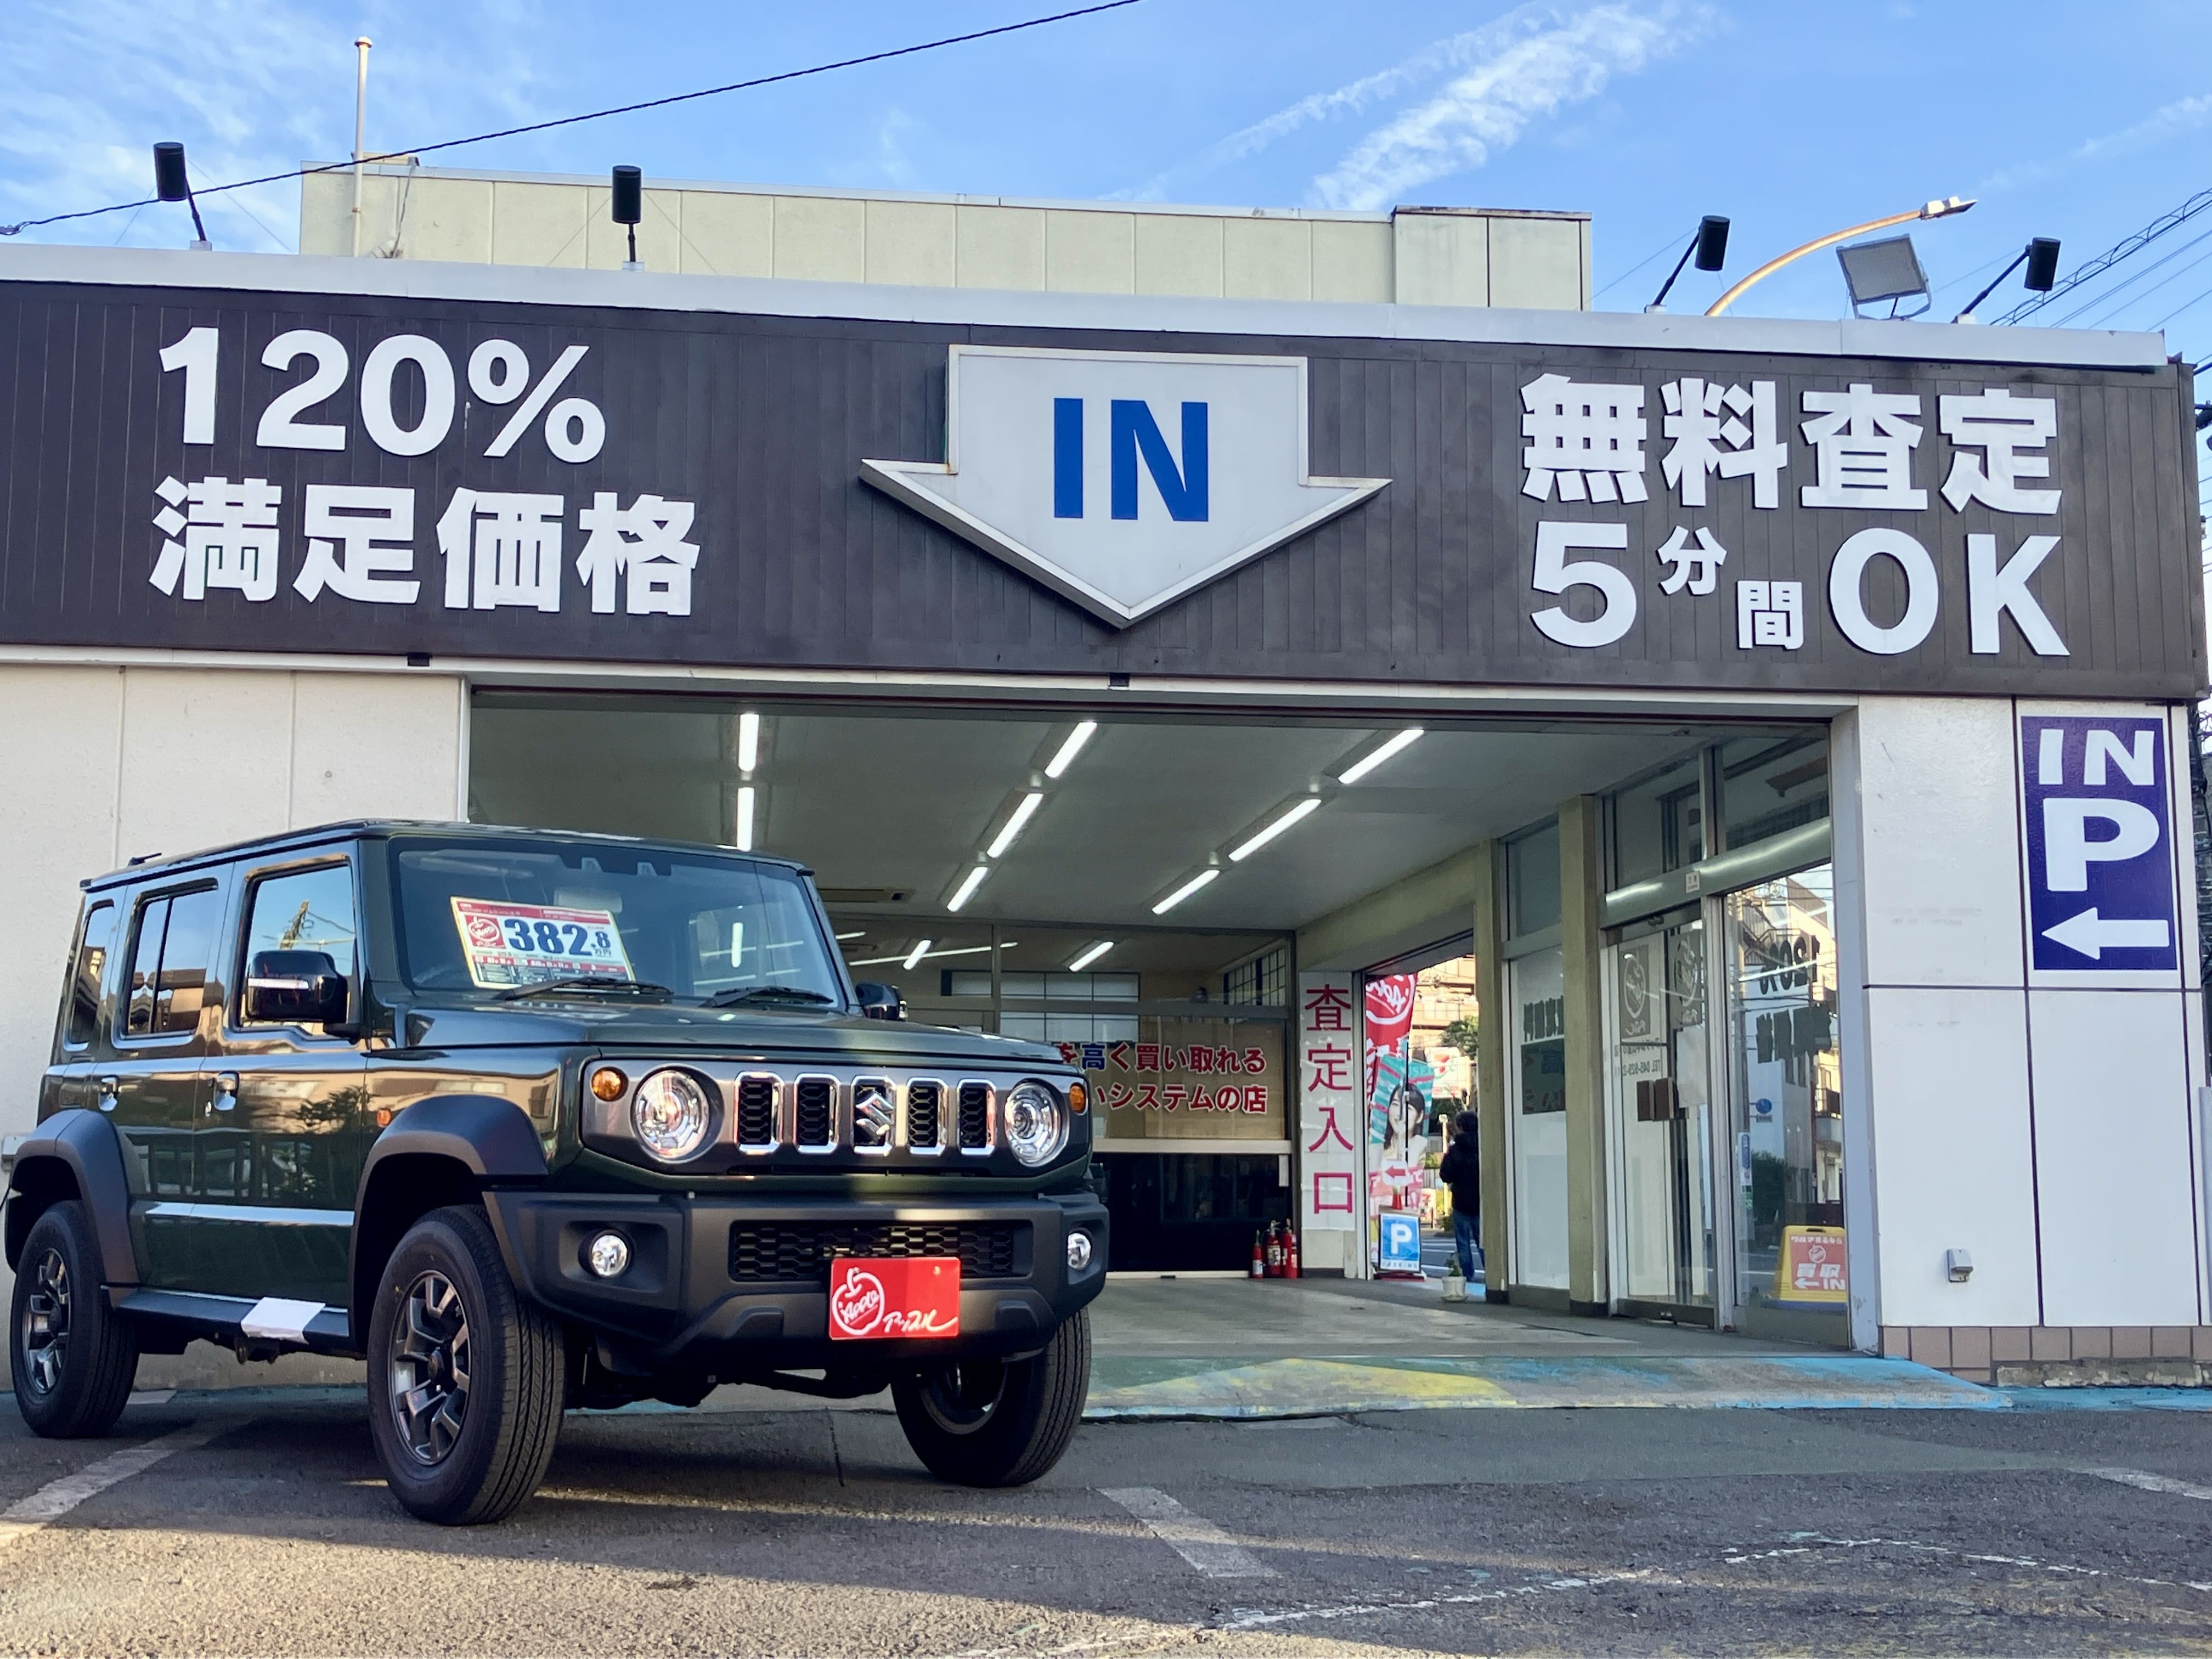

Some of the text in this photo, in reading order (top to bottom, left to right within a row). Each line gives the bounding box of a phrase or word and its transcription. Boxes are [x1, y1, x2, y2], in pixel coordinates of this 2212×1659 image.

[159, 326, 606, 464] 120%
[1520, 373, 2063, 515] 無料査定
[1053, 397, 1209, 522] IN
[148, 475, 701, 616] 満足価格
[2039, 728, 2155, 786] IN
[2042, 798, 2160, 891] P
[1305, 983, 1355, 1214] 査定入口
[1391, 1223, 1412, 1254] P
[1822, 1278, 1846, 1290] IN
